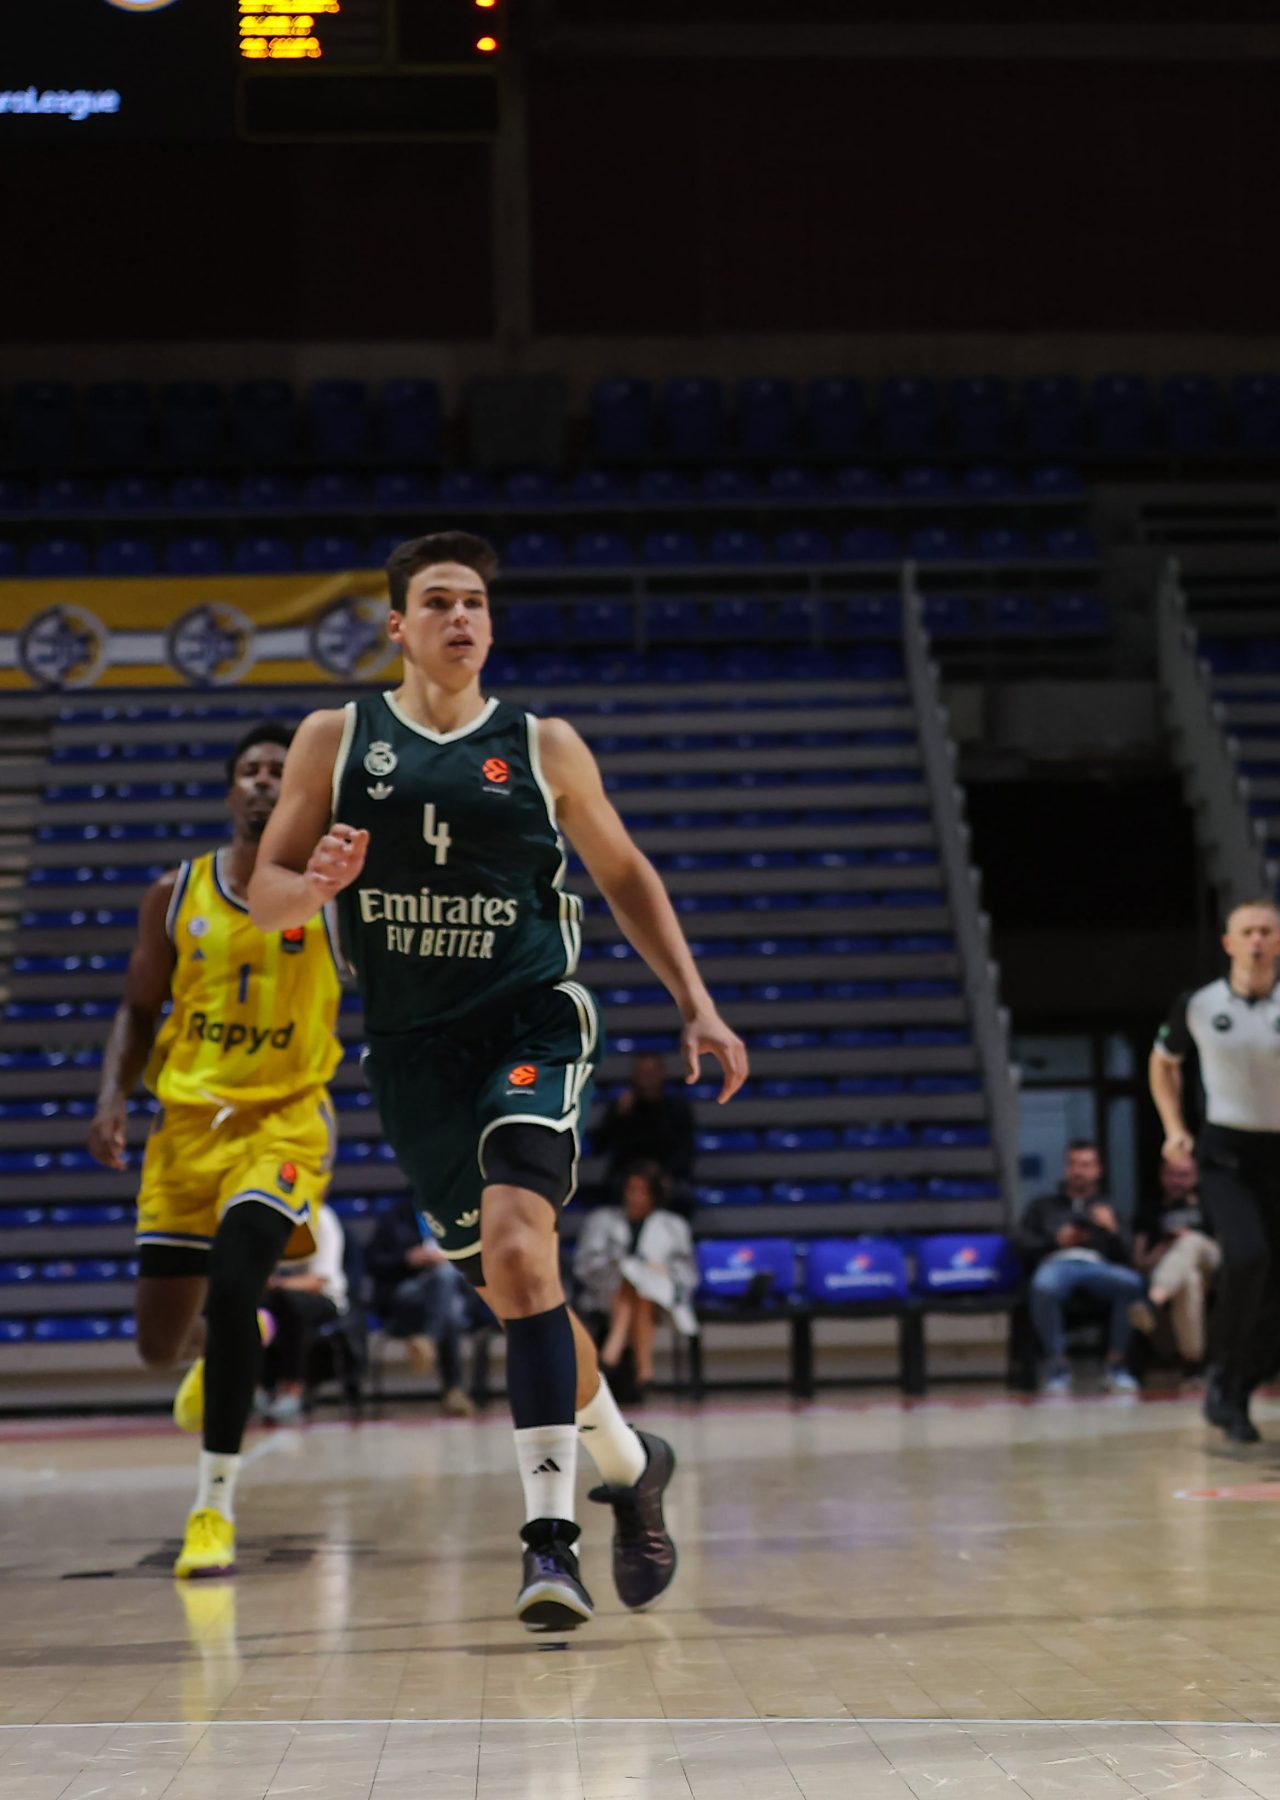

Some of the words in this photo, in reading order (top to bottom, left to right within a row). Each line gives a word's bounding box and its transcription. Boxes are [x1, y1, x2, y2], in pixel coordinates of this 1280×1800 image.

[422, 803, 452, 866] 4
[358, 887, 519, 928] Emirates
[385, 925, 413, 957] FLY
[419, 928, 496, 960] BETTER
[237, 962, 252, 1005] 1
[187, 1011, 294, 1056] Rapyd
